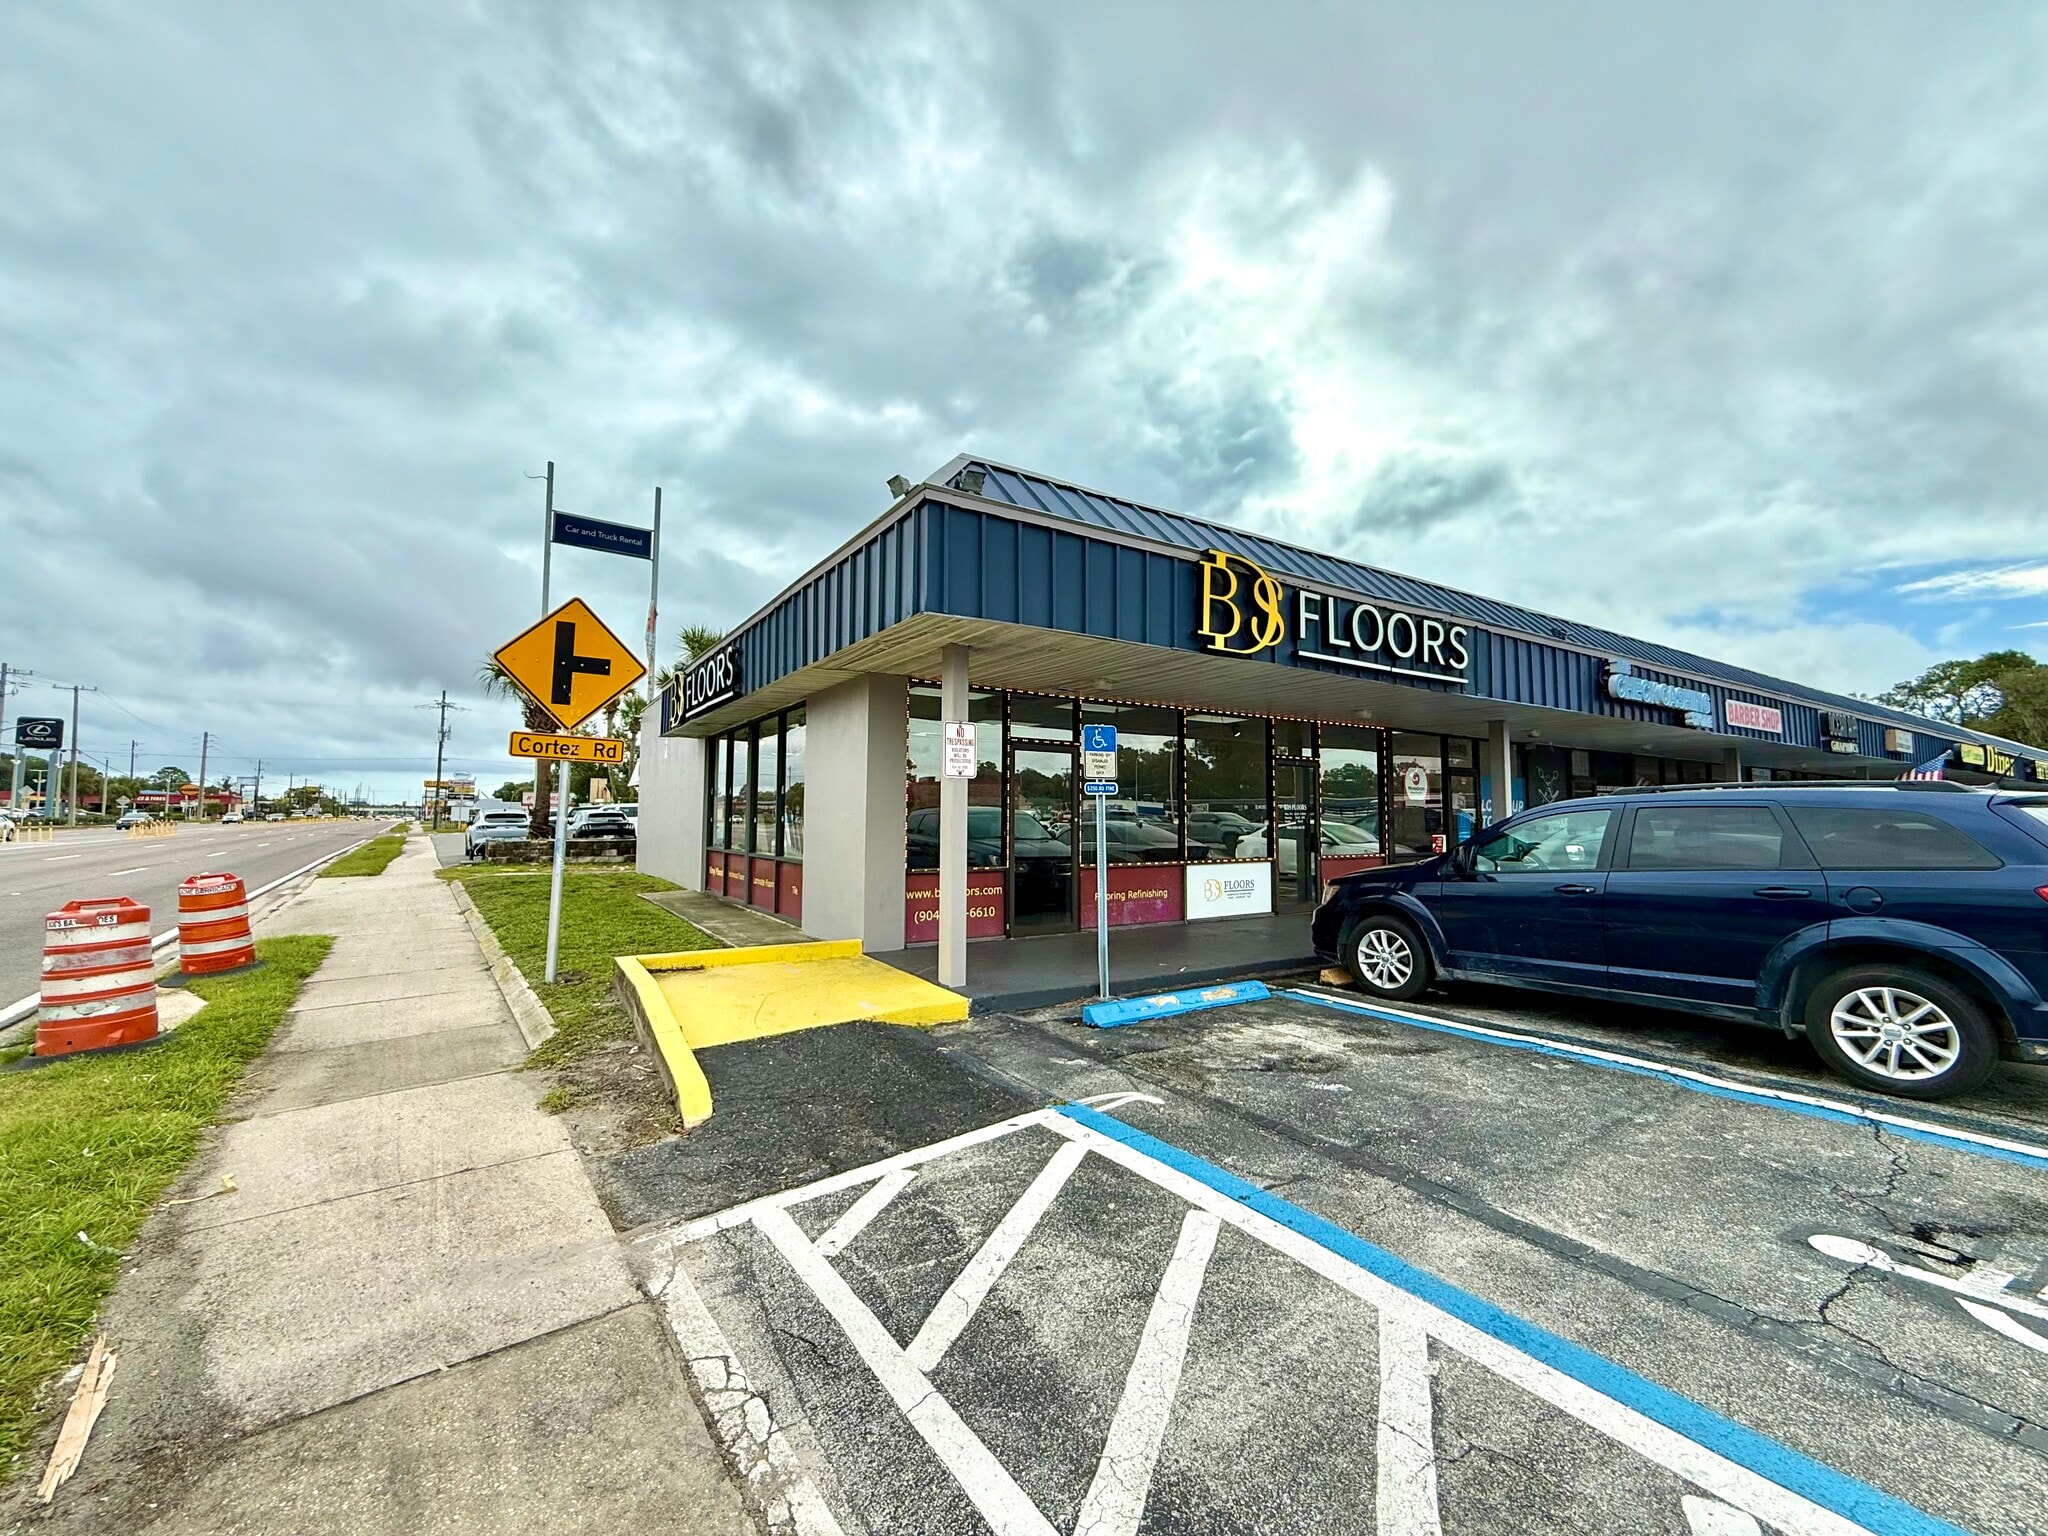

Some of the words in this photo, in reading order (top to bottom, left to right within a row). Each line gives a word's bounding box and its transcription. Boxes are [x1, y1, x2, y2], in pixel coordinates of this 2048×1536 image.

[565, 524, 580, 534] Car
[581, 529, 597, 538] and
[597, 530, 618, 542] Truck
[619, 535, 643, 547] Rental
[1299, 589, 1470, 671] FLOORS
[686, 646, 734, 710] FLOORS
[1728, 702, 1761, 728] BARBER
[1761, 711, 1780, 732] SHOP
[947, 737, 975, 747] TRESPASSING
[956, 727, 965, 738] NO
[518, 737, 580, 756] Cortez
[593, 742, 617, 759] Rd
[1985, 744, 2015, 777] Diner
[1095, 891, 1126, 902] Foring
[1127, 889, 1168, 900] Refinishing
[1224, 879, 1255, 890] FLOORS
